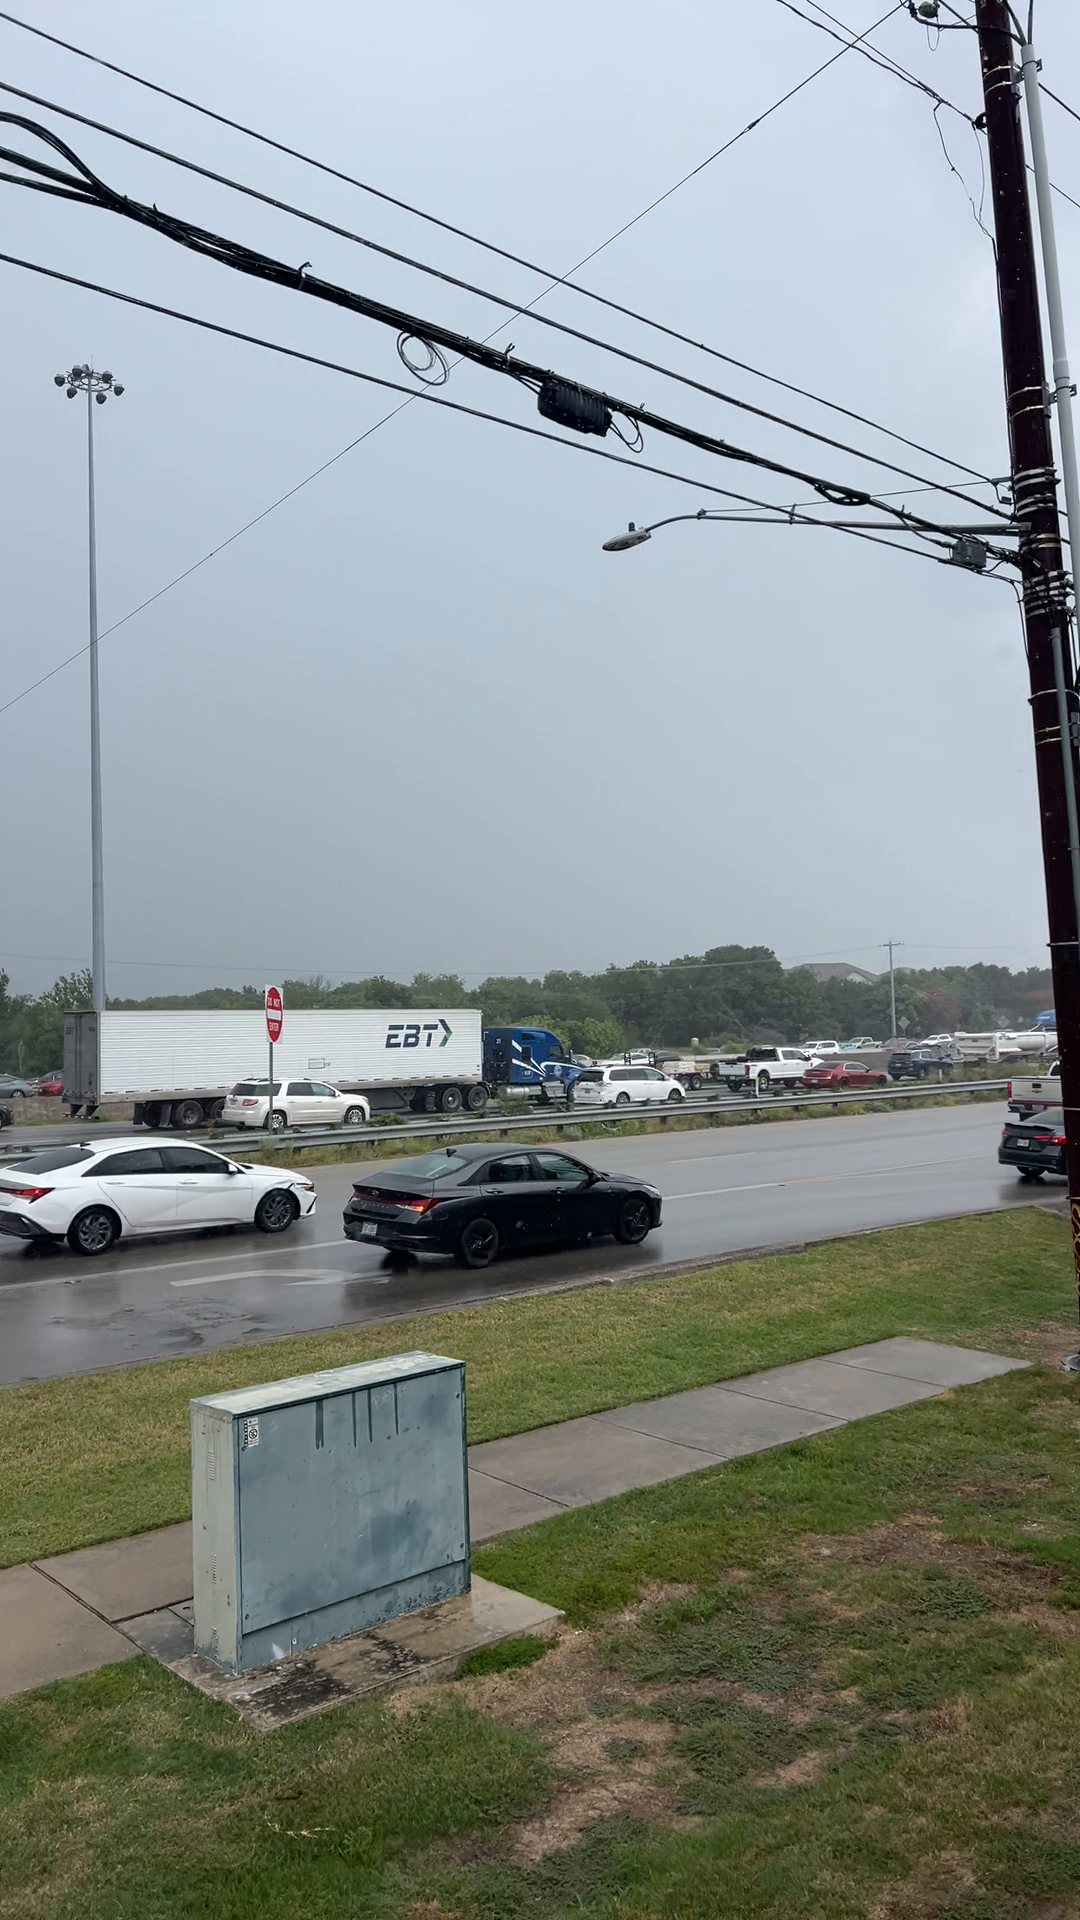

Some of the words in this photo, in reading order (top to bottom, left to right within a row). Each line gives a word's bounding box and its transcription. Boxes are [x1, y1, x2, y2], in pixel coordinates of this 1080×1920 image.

[267, 997, 273, 1006] DO
[273, 998, 281, 1007] NOT
[269, 1021, 279, 1031] ENTER
[385, 1024, 439, 1048] EBT
